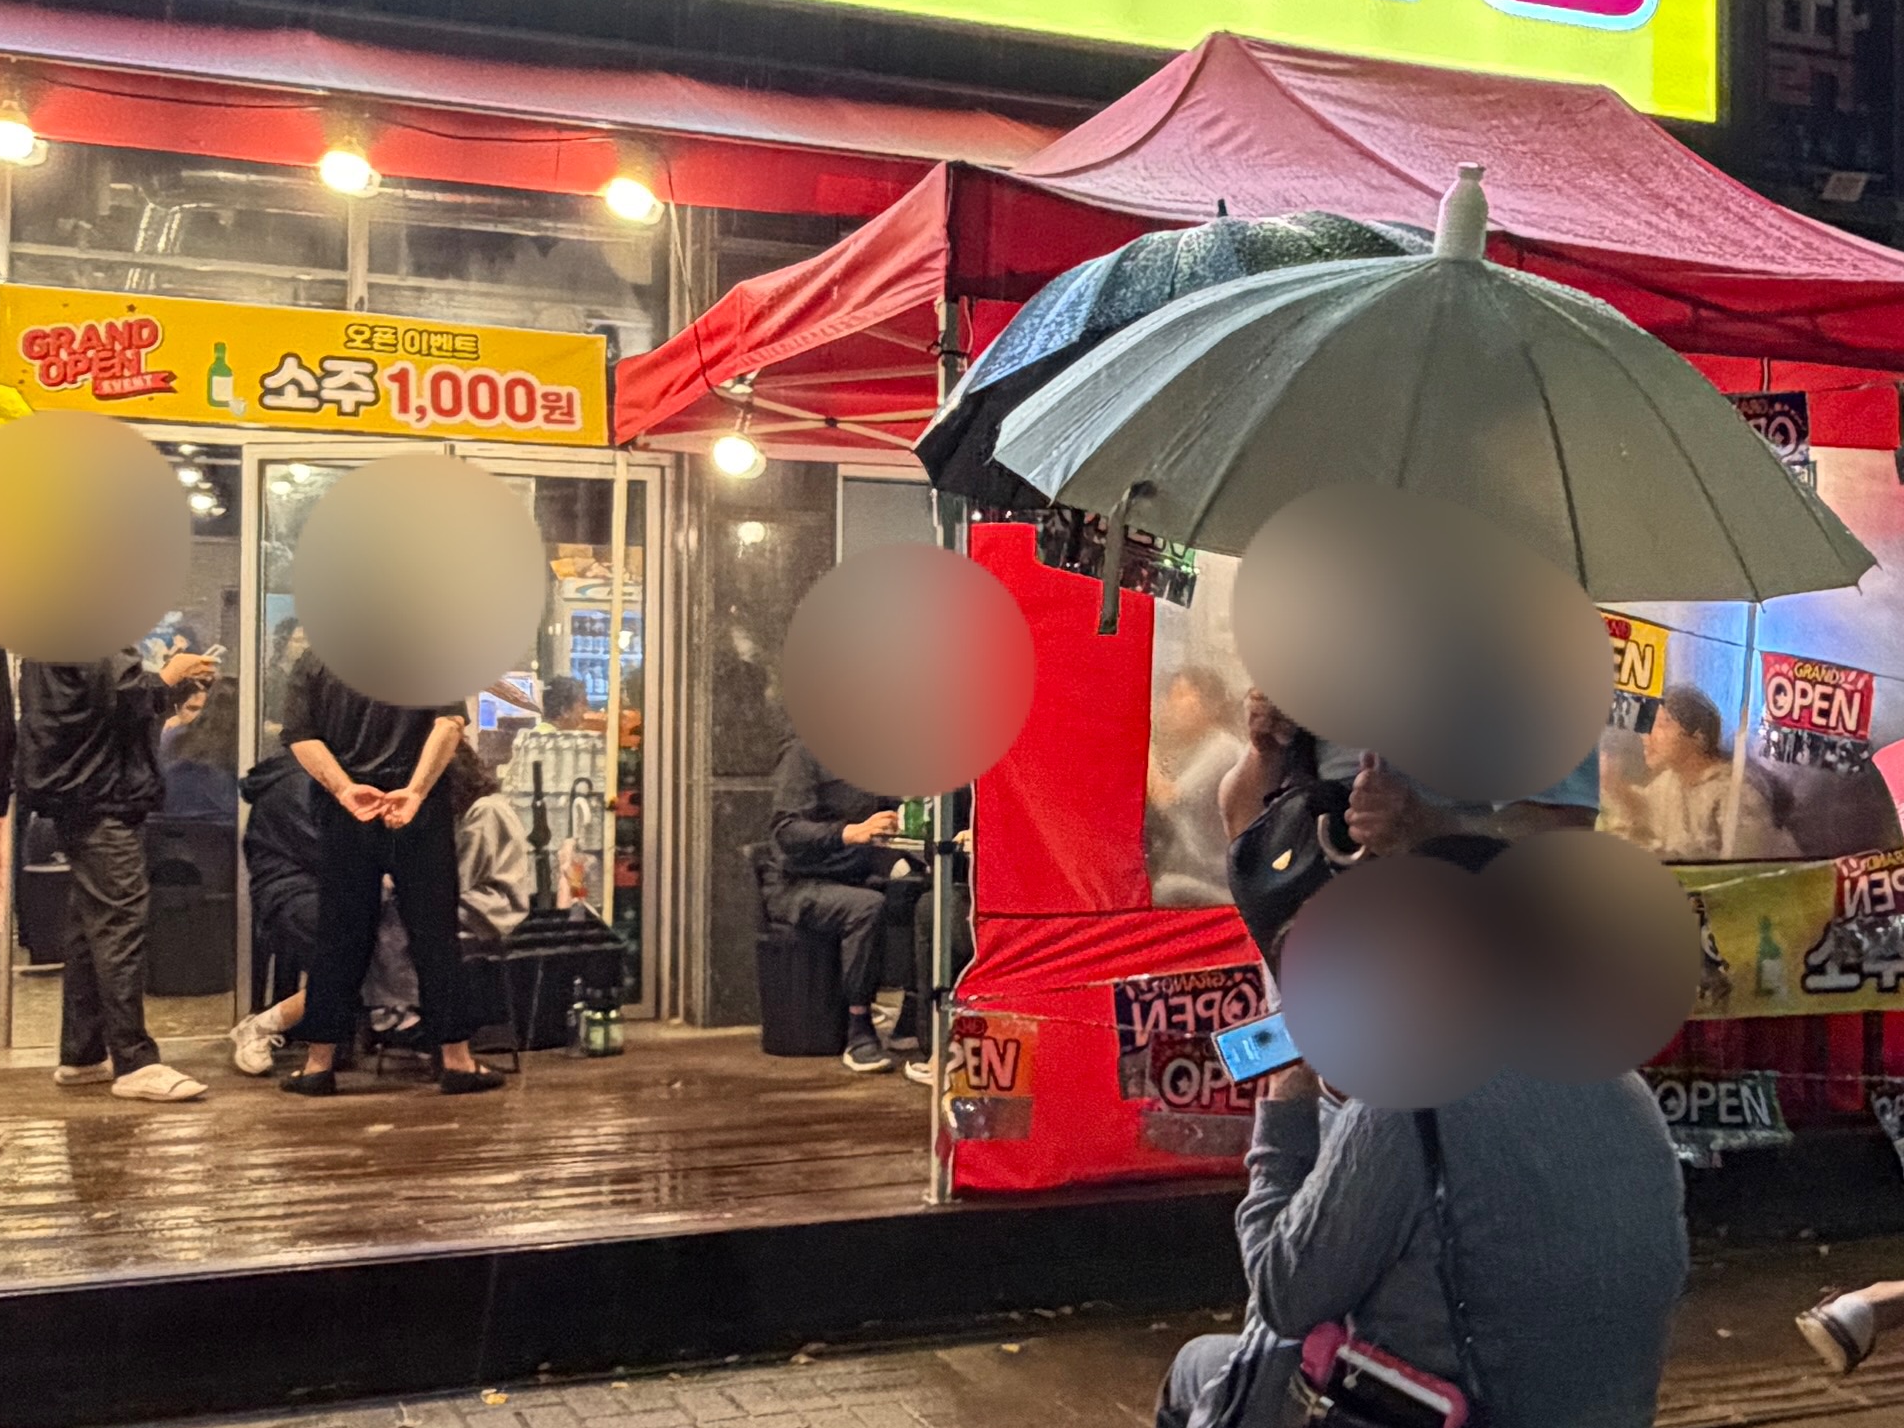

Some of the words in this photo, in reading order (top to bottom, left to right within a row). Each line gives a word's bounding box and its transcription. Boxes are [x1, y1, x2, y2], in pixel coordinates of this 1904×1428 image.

[22, 317, 160, 361] GRAND
[346, 324, 399, 353] 오픈
[402, 329, 481, 360] 이벤트
[38, 346, 143, 387] OPEN
[259, 353, 381, 417] 소주
[1766, 675, 1862, 732] OPEN
[1655, 1079, 1773, 1126] OPEN
